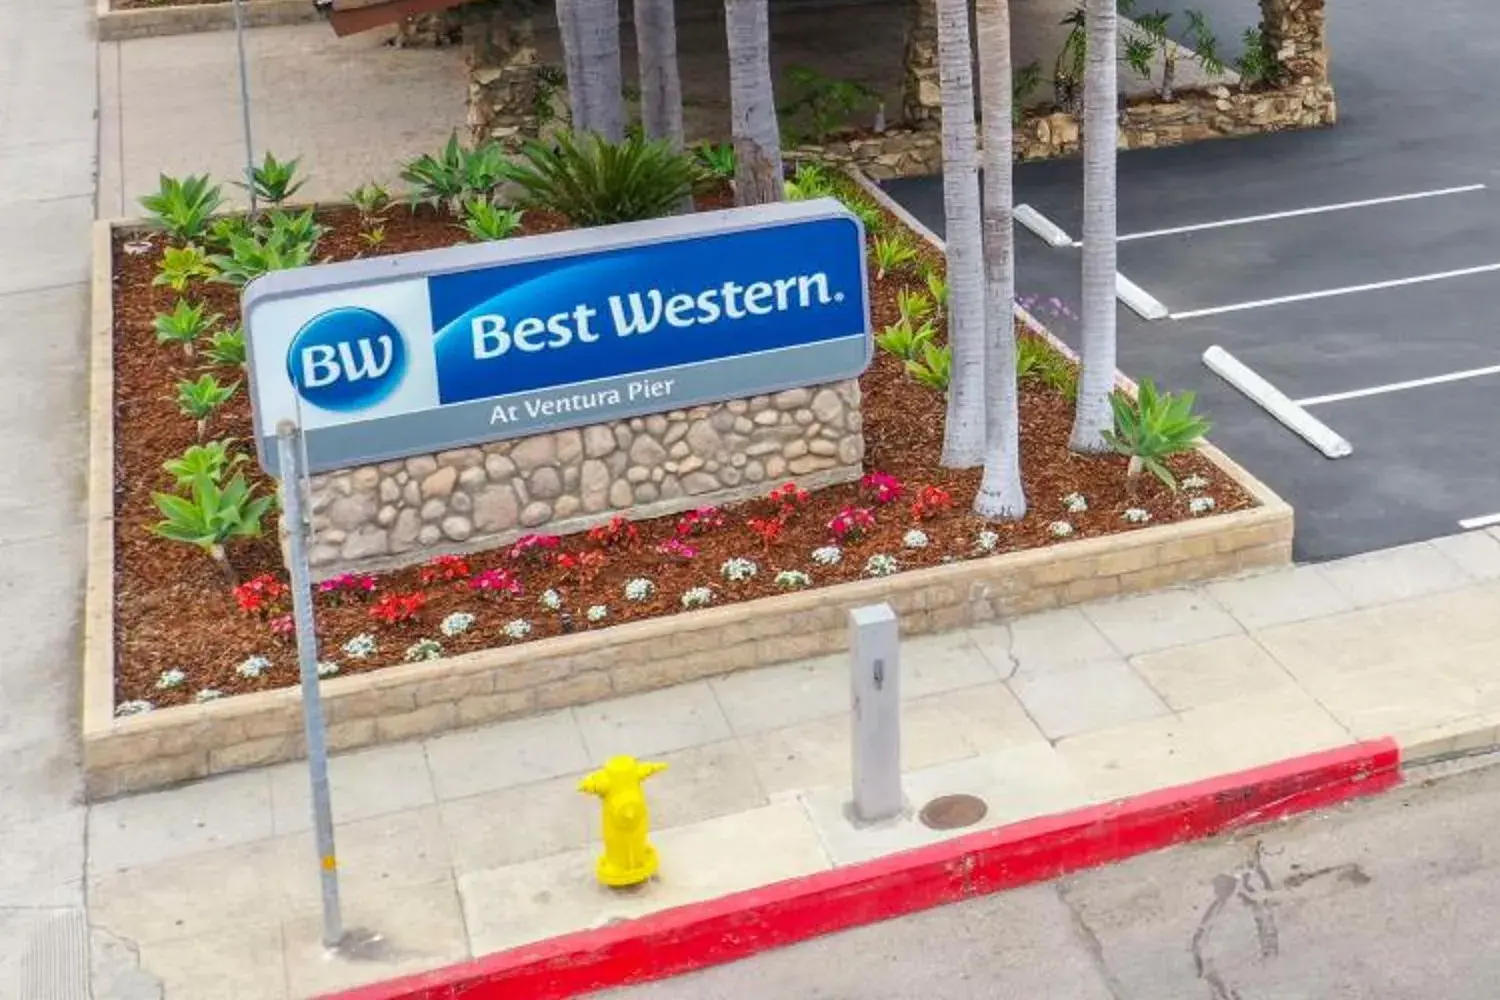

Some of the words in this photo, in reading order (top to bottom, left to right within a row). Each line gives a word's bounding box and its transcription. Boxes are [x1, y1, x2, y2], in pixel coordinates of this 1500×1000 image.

[472, 304, 599, 359] Best
[301, 335, 393, 388] BW
[489, 405, 518, 426] At
[524, 387, 620, 418] Ventura
[628, 377, 676, 401] Pier
